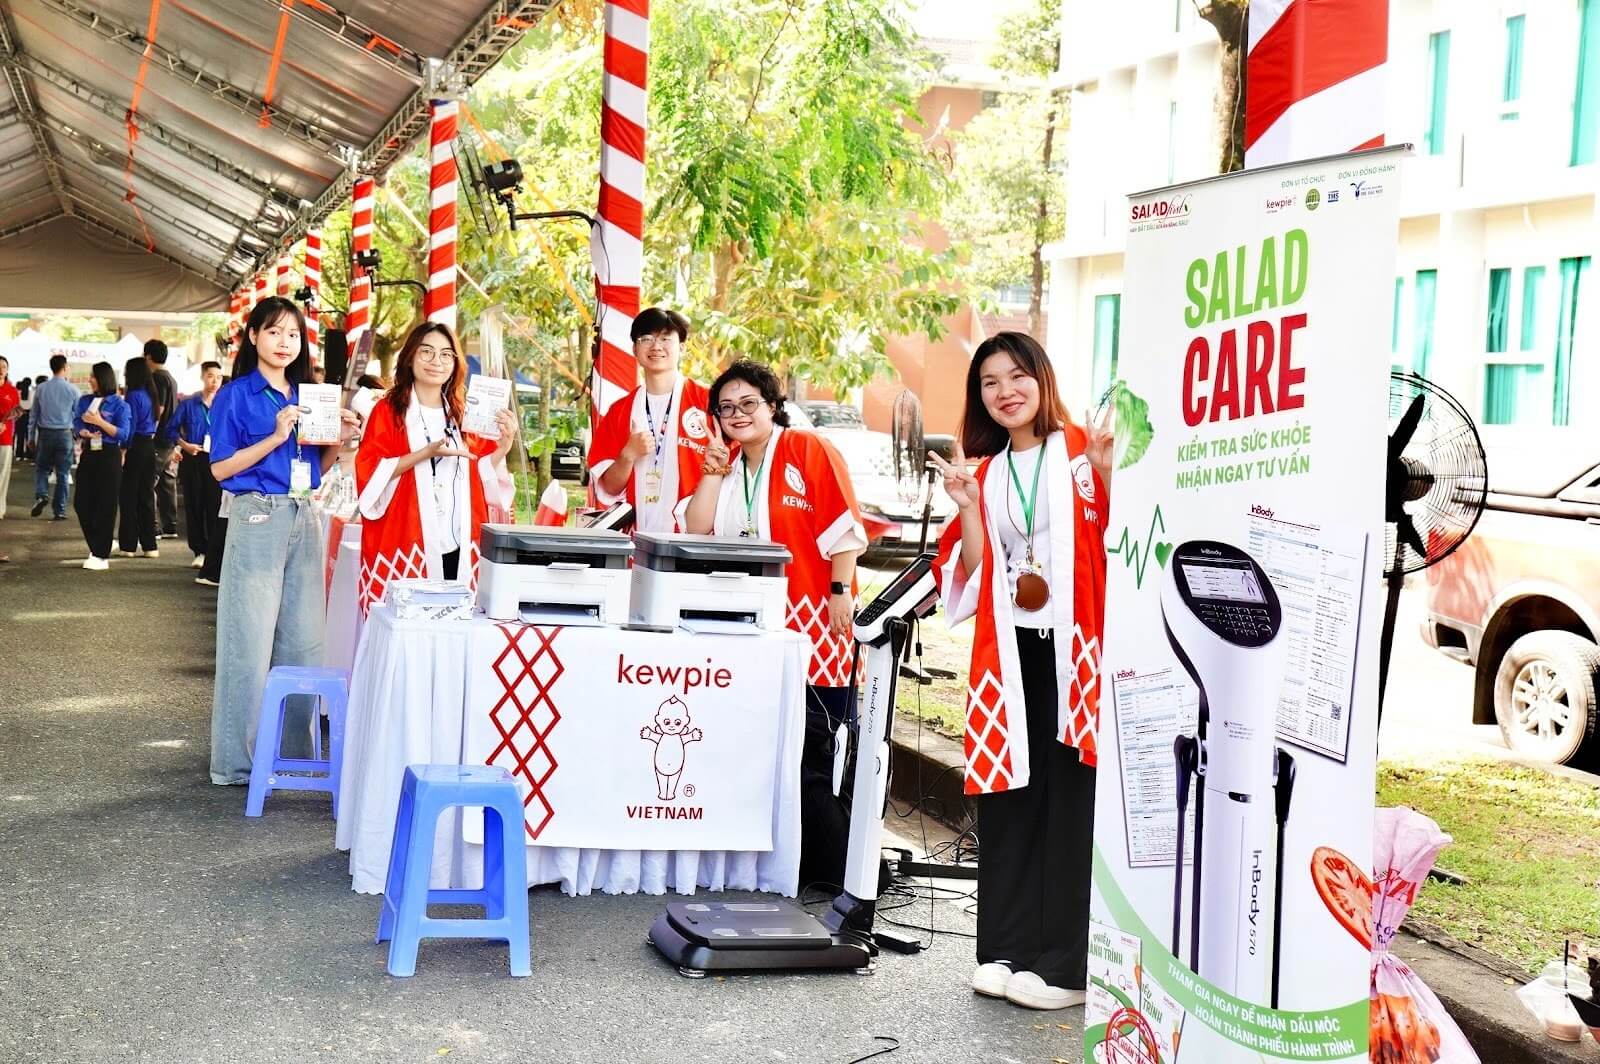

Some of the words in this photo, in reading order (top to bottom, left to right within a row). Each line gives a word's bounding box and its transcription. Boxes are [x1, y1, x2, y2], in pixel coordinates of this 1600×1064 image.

[1131, 201, 1168, 220] SALAD
[1184, 228, 1309, 329] SALAD
[1182, 313, 1307, 427] CARE
[1177, 434, 1208, 463] KIỂM
[1211, 438, 1237, 457] TRA
[1241, 428, 1268, 453] SỨC
[1270, 420, 1311, 449] KHỎE
[1176, 465, 1212, 492] NHẬN
[1215, 462, 1254, 485] NGAY
[1257, 456, 1277, 479] TƯ
[1278, 447, 1310, 476] VẤN
[1251, 504, 1275, 518] InBody
[617, 654, 732, 694] kewpie
[626, 806, 703, 820] VIETNAM
[1168, 962, 1194, 991] THAM
[1195, 984, 1210, 1003] GIA
[1212, 994, 1239, 1017] NGAY
[1241, 1005, 1257, 1024] ĐỂ
[1256, 1013, 1287, 1034] NHẬN
[1290, 1013, 1313, 1034] DẤU
[1314, 1015, 1341, 1037] MỘC
[1195, 1004, 1222, 1030] HOÀN
[1223, 1021, 1258, 1047] THÀNH
[1259, 1034, 1289, 1055] PHIẾU
[1290, 1038, 1322, 1057] HÀNH
[1322, 1037, 1356, 1056] TRÌNH
